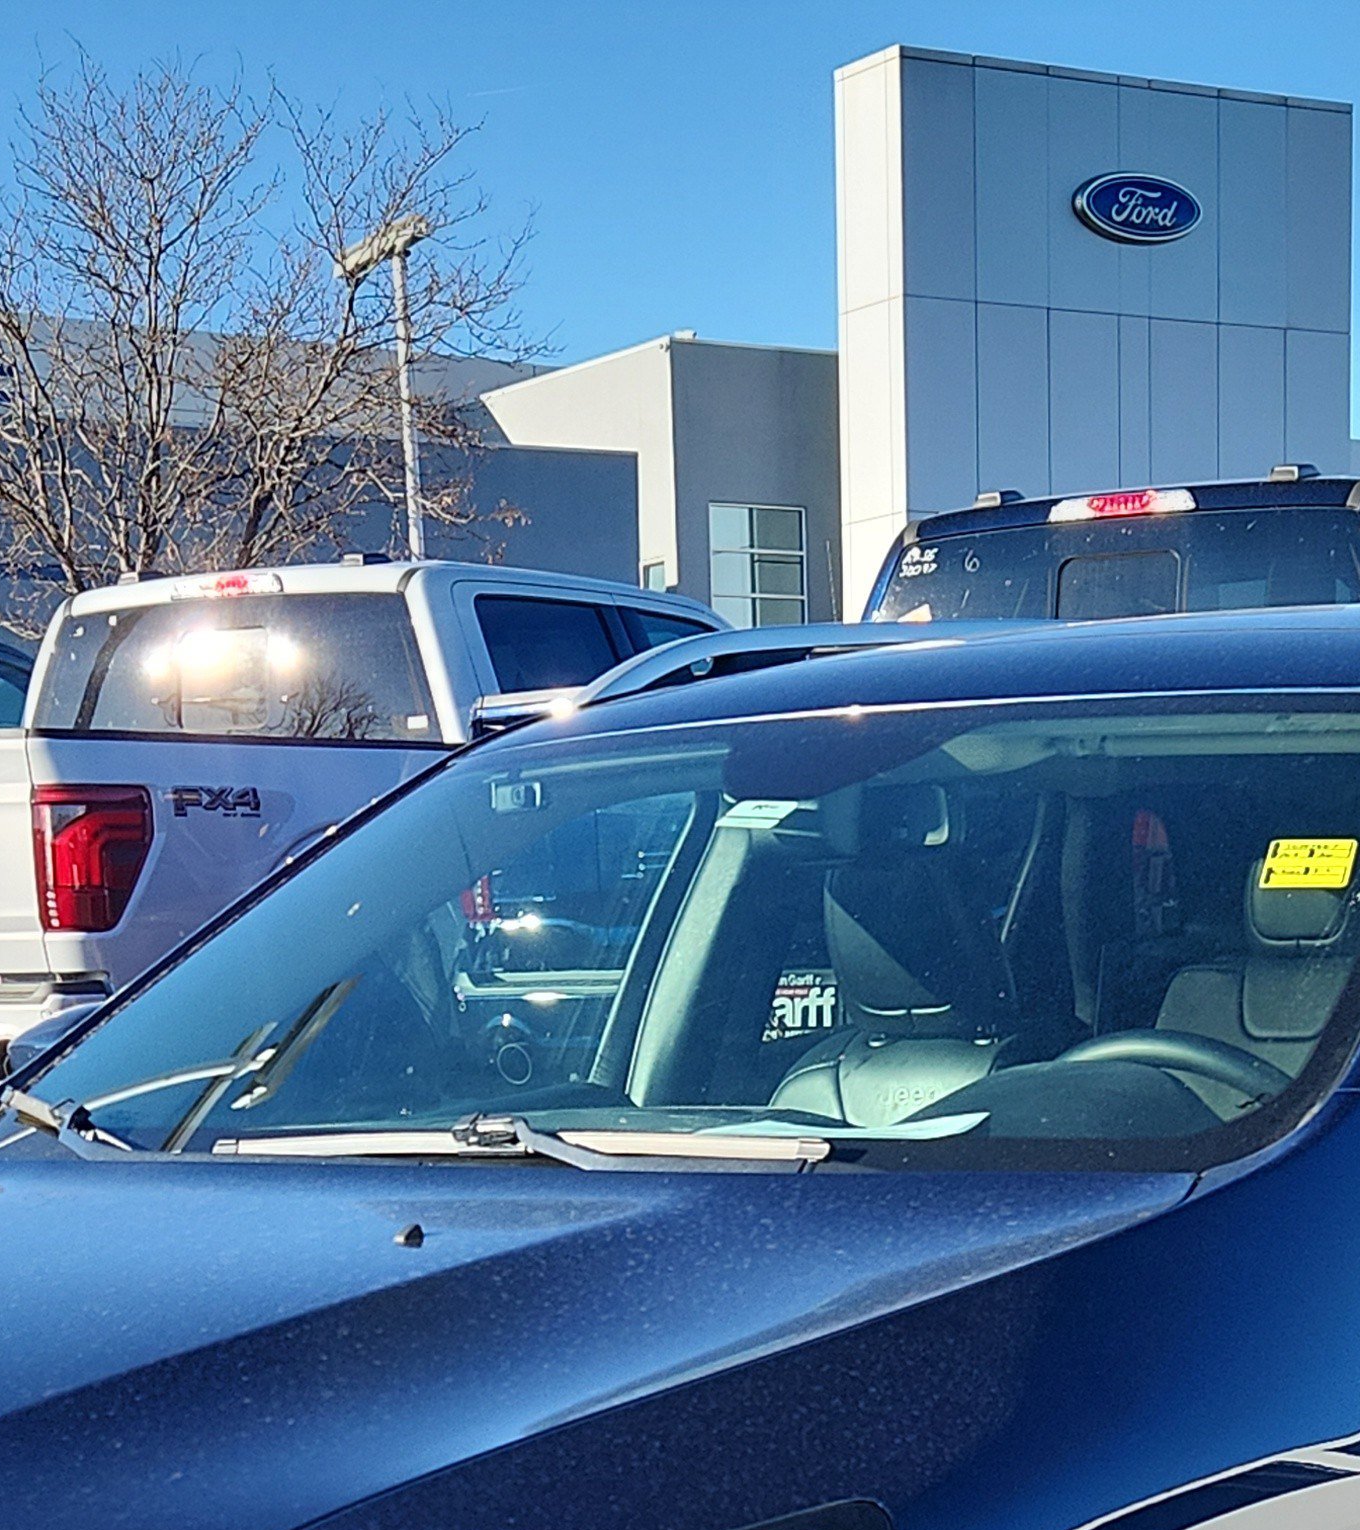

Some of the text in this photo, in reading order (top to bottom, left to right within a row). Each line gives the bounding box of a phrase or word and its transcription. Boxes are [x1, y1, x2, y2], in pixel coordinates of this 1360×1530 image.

[1111, 187, 1178, 227] Ford
[171, 784, 261, 817] FX4
[771, 986, 836, 1027] arff
